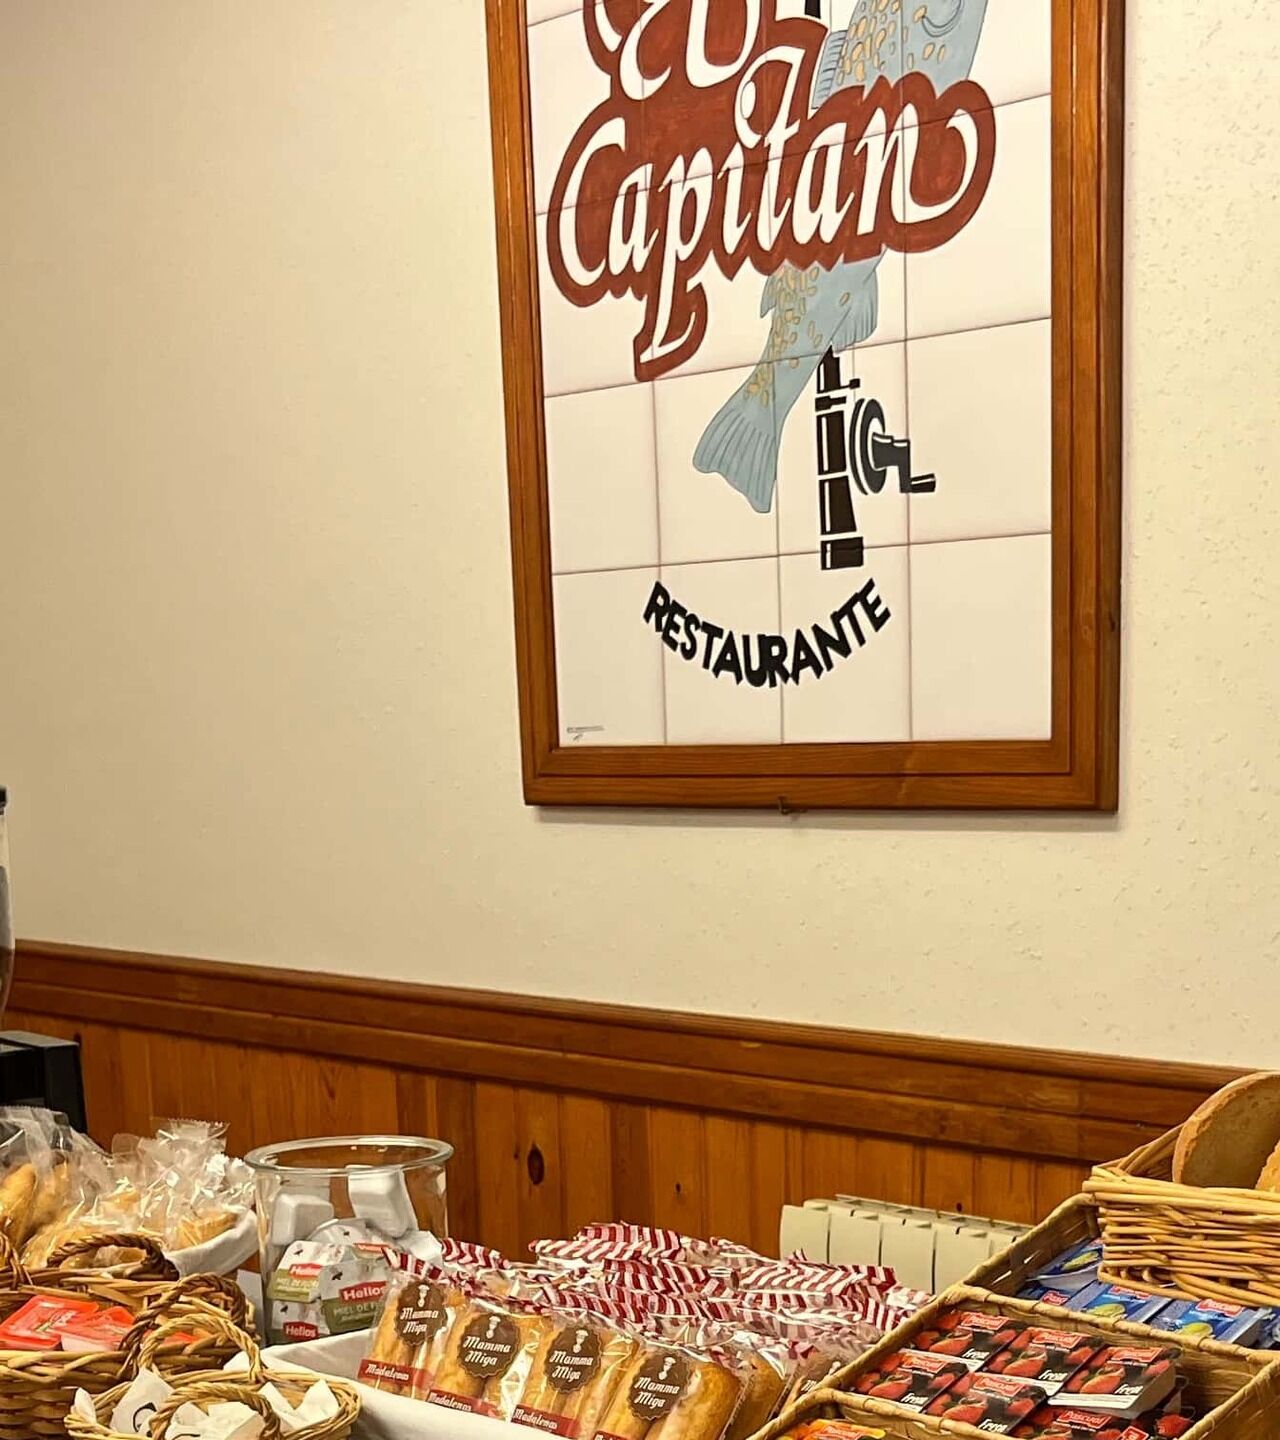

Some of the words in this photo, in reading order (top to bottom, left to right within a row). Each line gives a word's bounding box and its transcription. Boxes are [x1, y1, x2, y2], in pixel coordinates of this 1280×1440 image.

[643, 578, 892, 688] RESTAURANTE
[463, 1336, 512, 1353] Mamma
[465, 1350, 498, 1367] Miga
[549, 1350, 594, 1366] Mamma
[552, 1366, 582, 1382] Miga
[634, 1377, 680, 1394] Mamma
[634, 1392, 666, 1409] Miga
